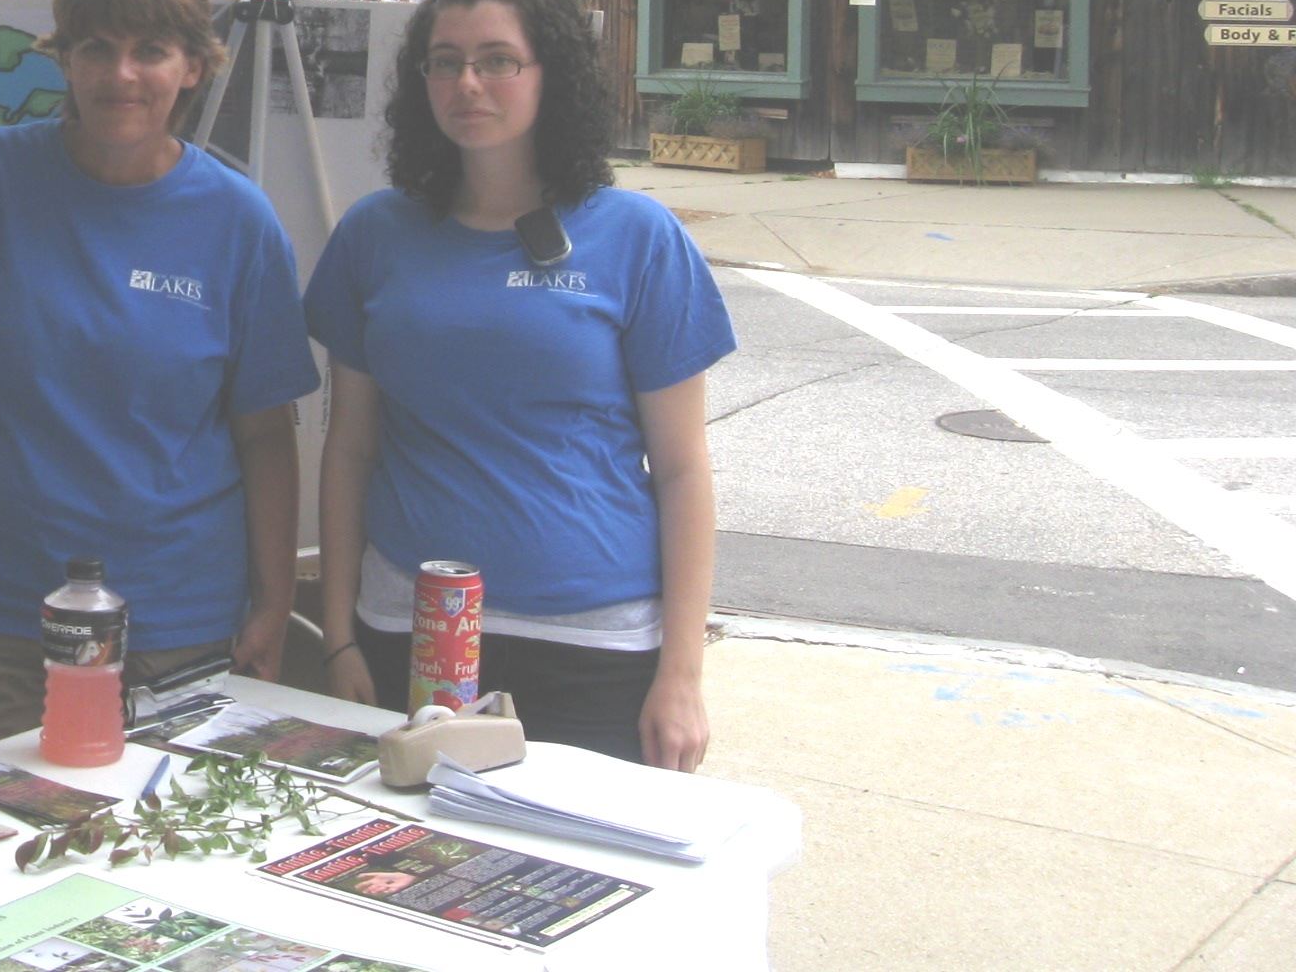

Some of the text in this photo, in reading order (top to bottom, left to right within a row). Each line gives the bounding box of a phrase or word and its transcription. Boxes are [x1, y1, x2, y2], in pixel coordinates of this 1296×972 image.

[1218, 3, 1272, 16] Facials
[1220, 28, 1261, 43] Body
[1268, 29, 1280, 41] &
[151, 275, 203, 301] LAKES
[529, 272, 587, 291] LAKES
